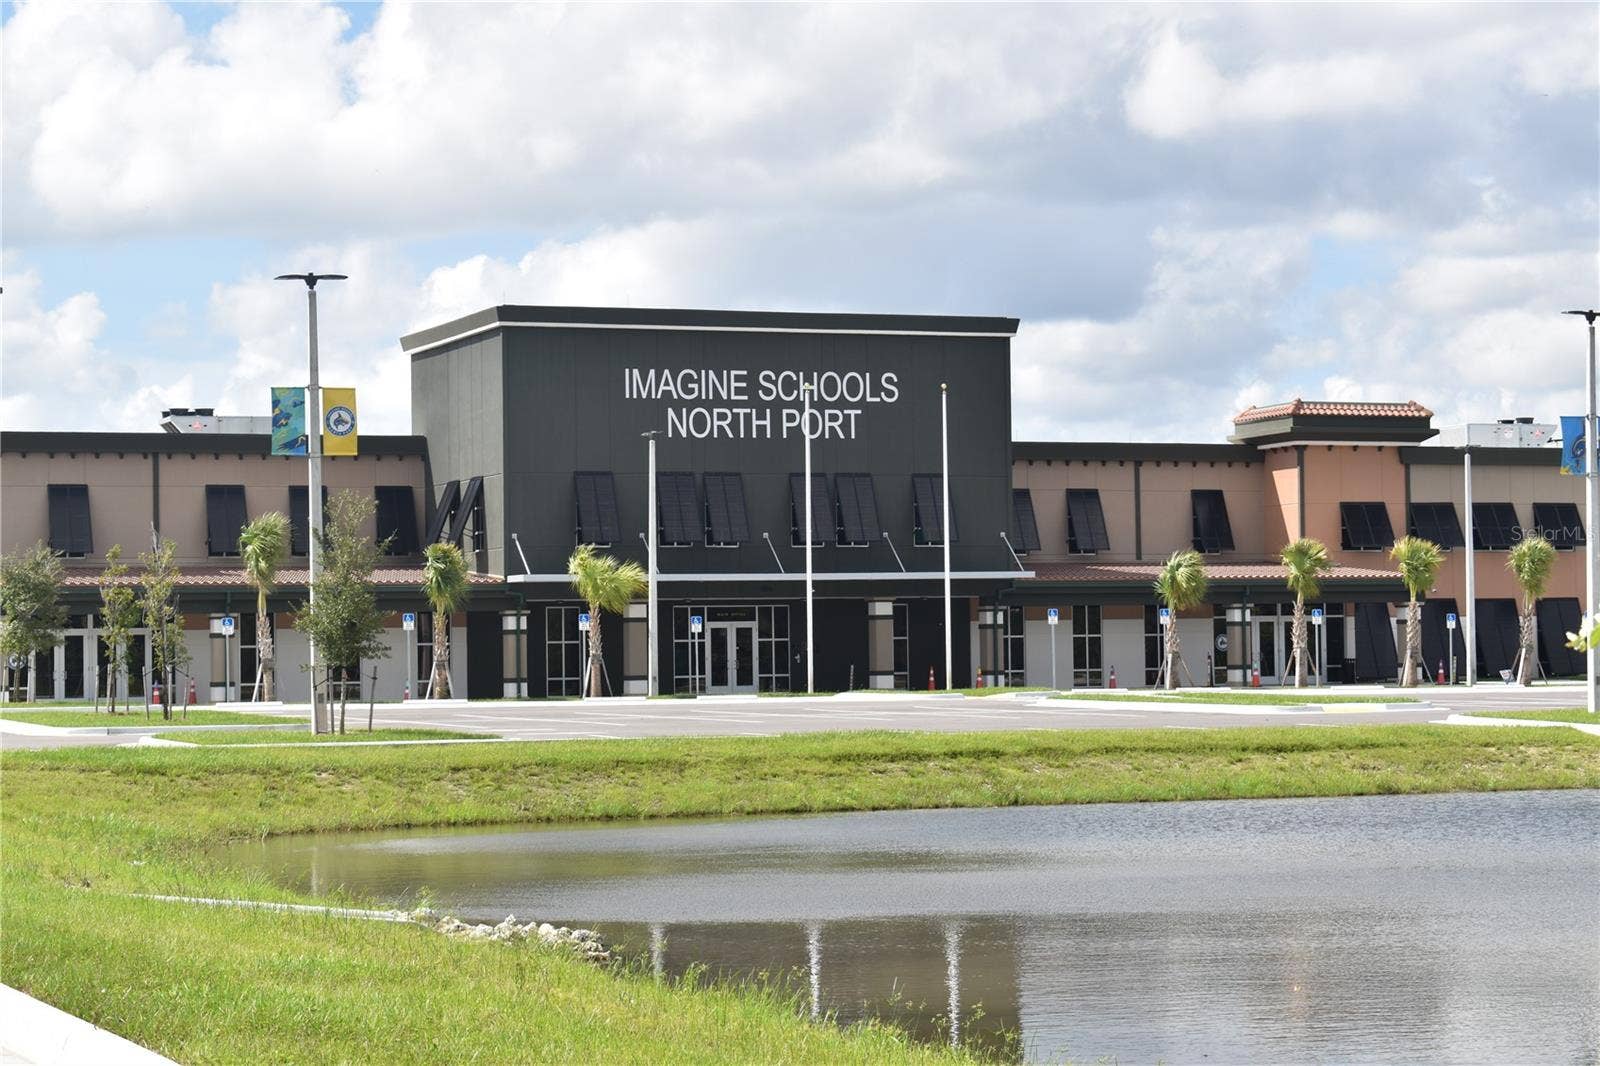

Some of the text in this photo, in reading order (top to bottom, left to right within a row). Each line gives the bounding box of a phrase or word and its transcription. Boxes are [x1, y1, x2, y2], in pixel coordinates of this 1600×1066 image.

[624, 368, 899, 402] IMAGINE SCHOOLS
[667, 407, 862, 439] NORTH PORT
